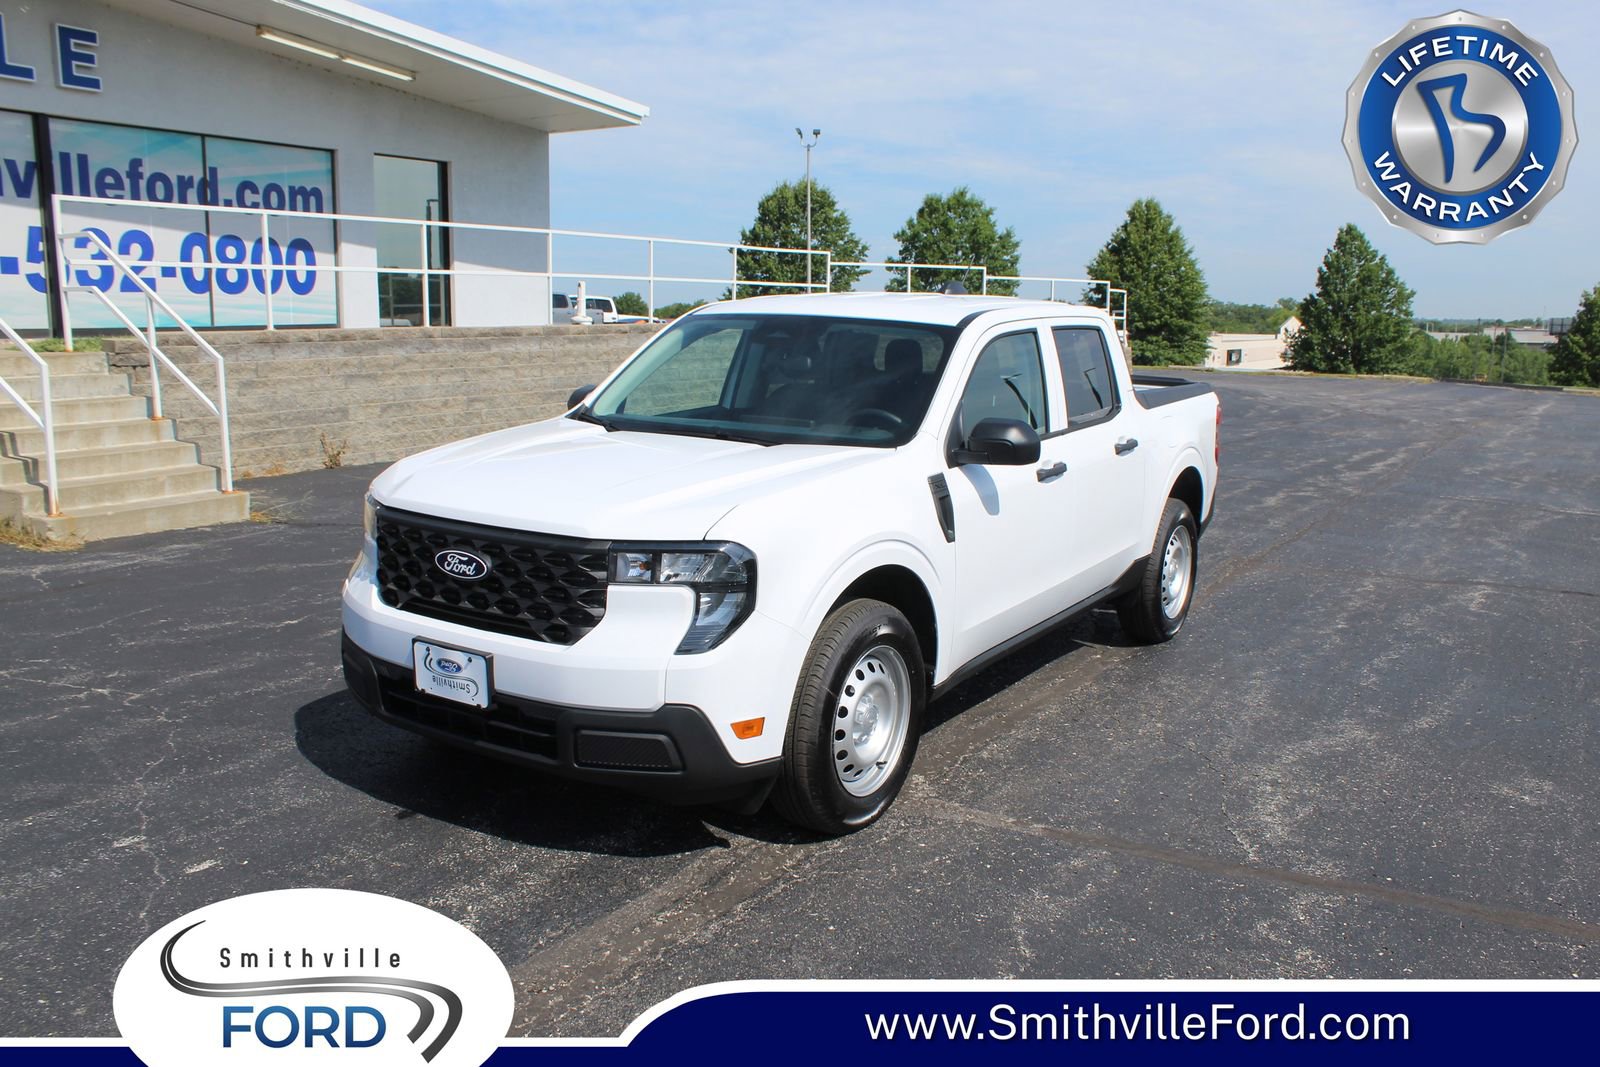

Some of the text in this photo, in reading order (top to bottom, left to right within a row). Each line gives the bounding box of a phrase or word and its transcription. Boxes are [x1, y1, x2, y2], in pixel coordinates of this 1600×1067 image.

[0, 151, 324, 216] vlleford.com
[444, 553, 476, 576] Ford
[432, 675, 471, 694] Smithville
